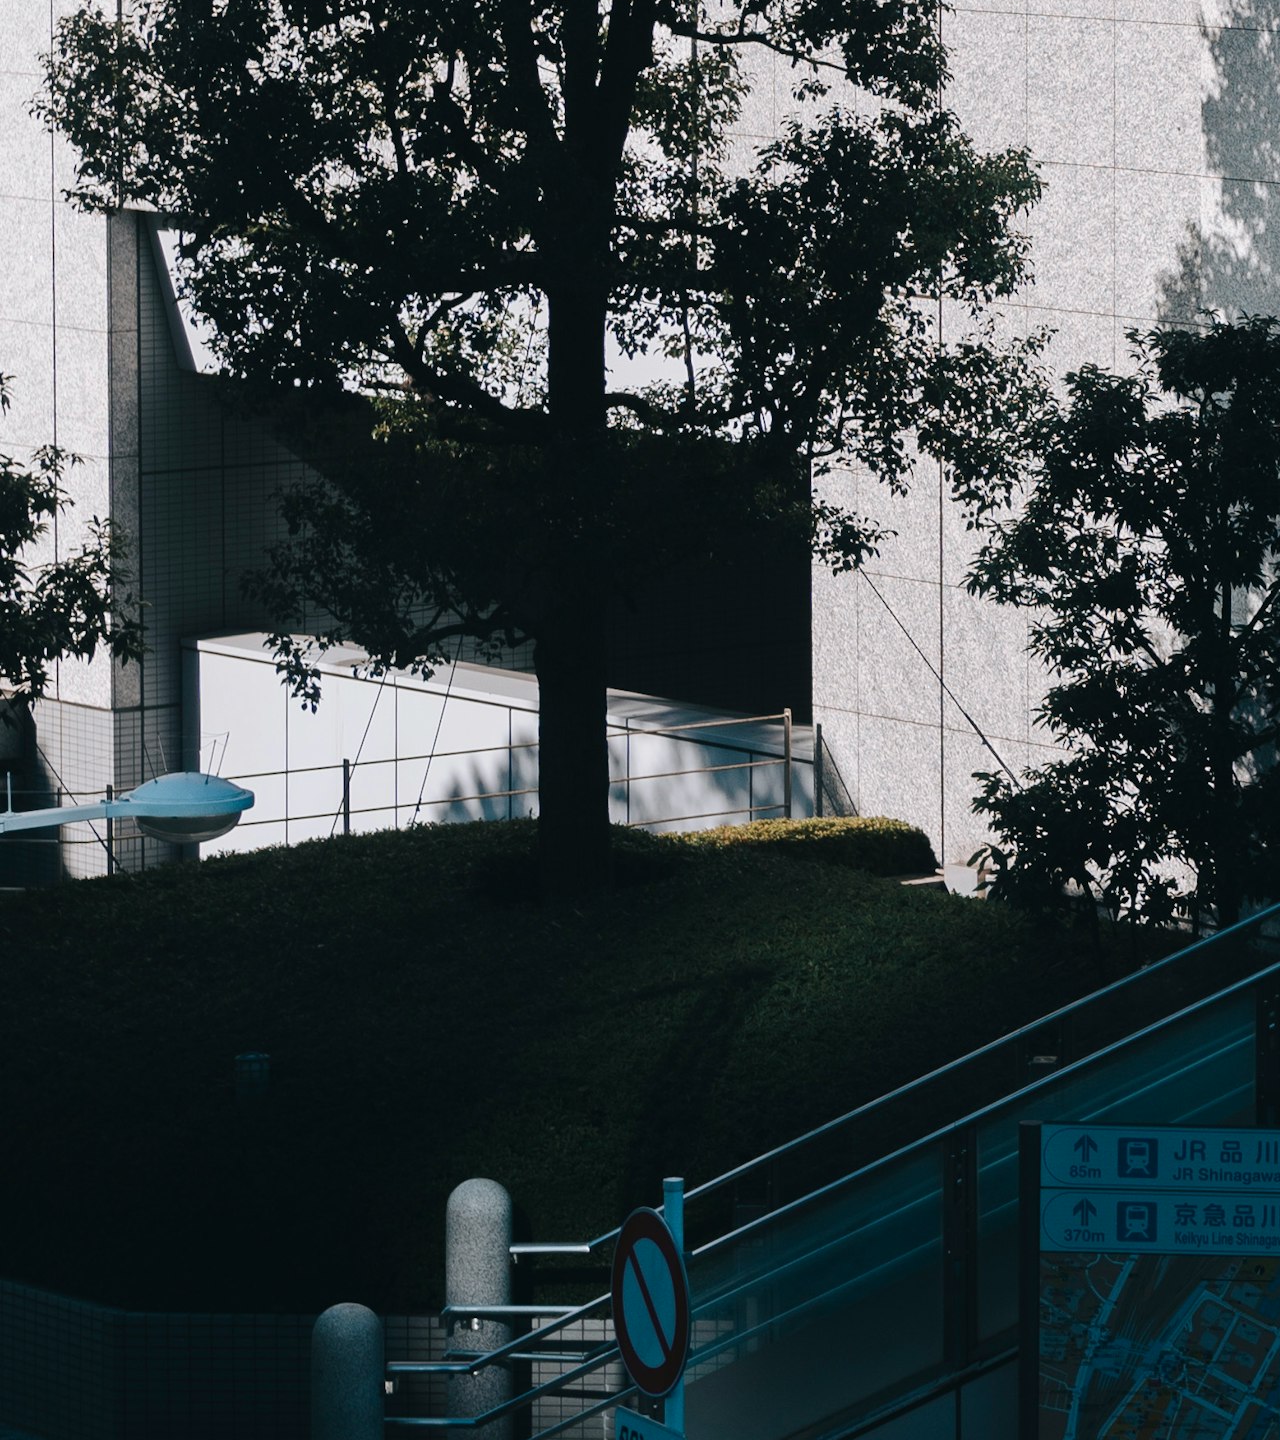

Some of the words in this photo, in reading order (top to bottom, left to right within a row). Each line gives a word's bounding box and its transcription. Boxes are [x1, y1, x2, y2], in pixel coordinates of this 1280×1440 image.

[1174, 1138, 1207, 1162] JR
[1069, 1164, 1102, 1179] 85m
[1172, 1167, 1194, 1182] JR
[1063, 1228, 1105, 1243] 370m
[1174, 1231, 1209, 1248] Keikyu
[1211, 1231, 1233, 1246] Line
